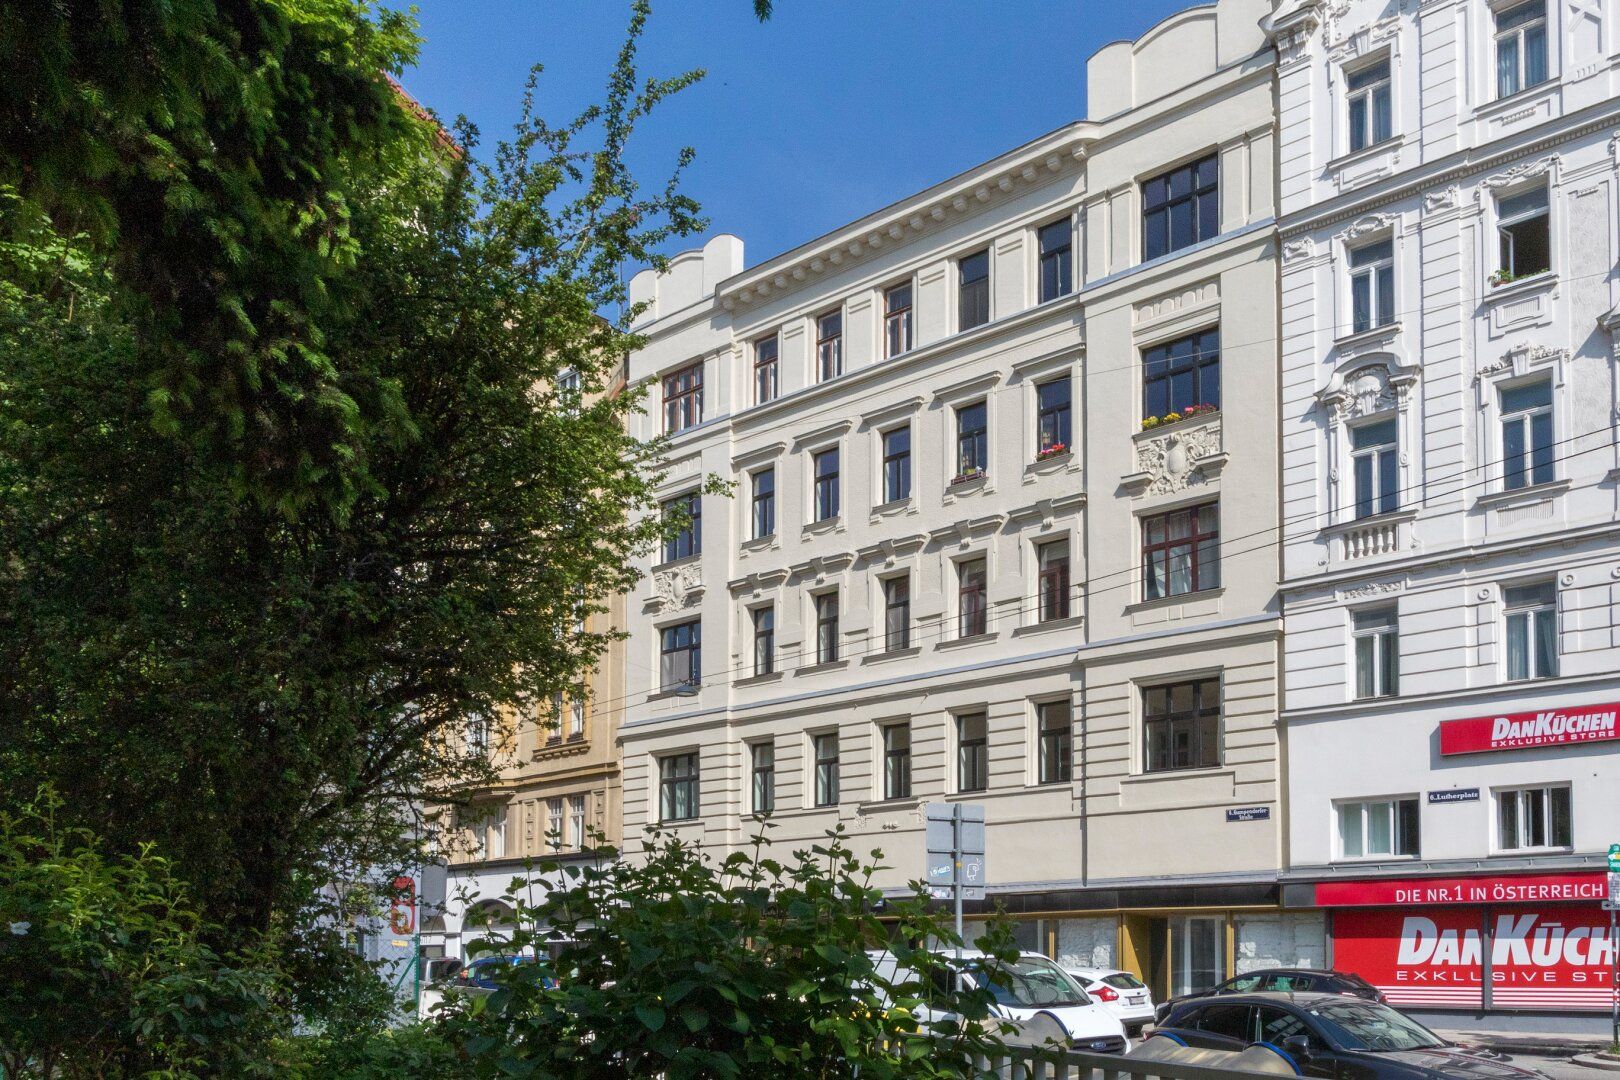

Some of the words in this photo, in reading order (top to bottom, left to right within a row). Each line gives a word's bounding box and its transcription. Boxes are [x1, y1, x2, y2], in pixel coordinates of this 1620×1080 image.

[1491, 735, 1565, 747] EXKLUSIVE
[1570, 730, 1615, 740] STORE
[1396, 889, 1421, 902] DIE
[1470, 887, 1487, 900] IN
[1493, 883, 1604, 900] ÖSTERREICH
